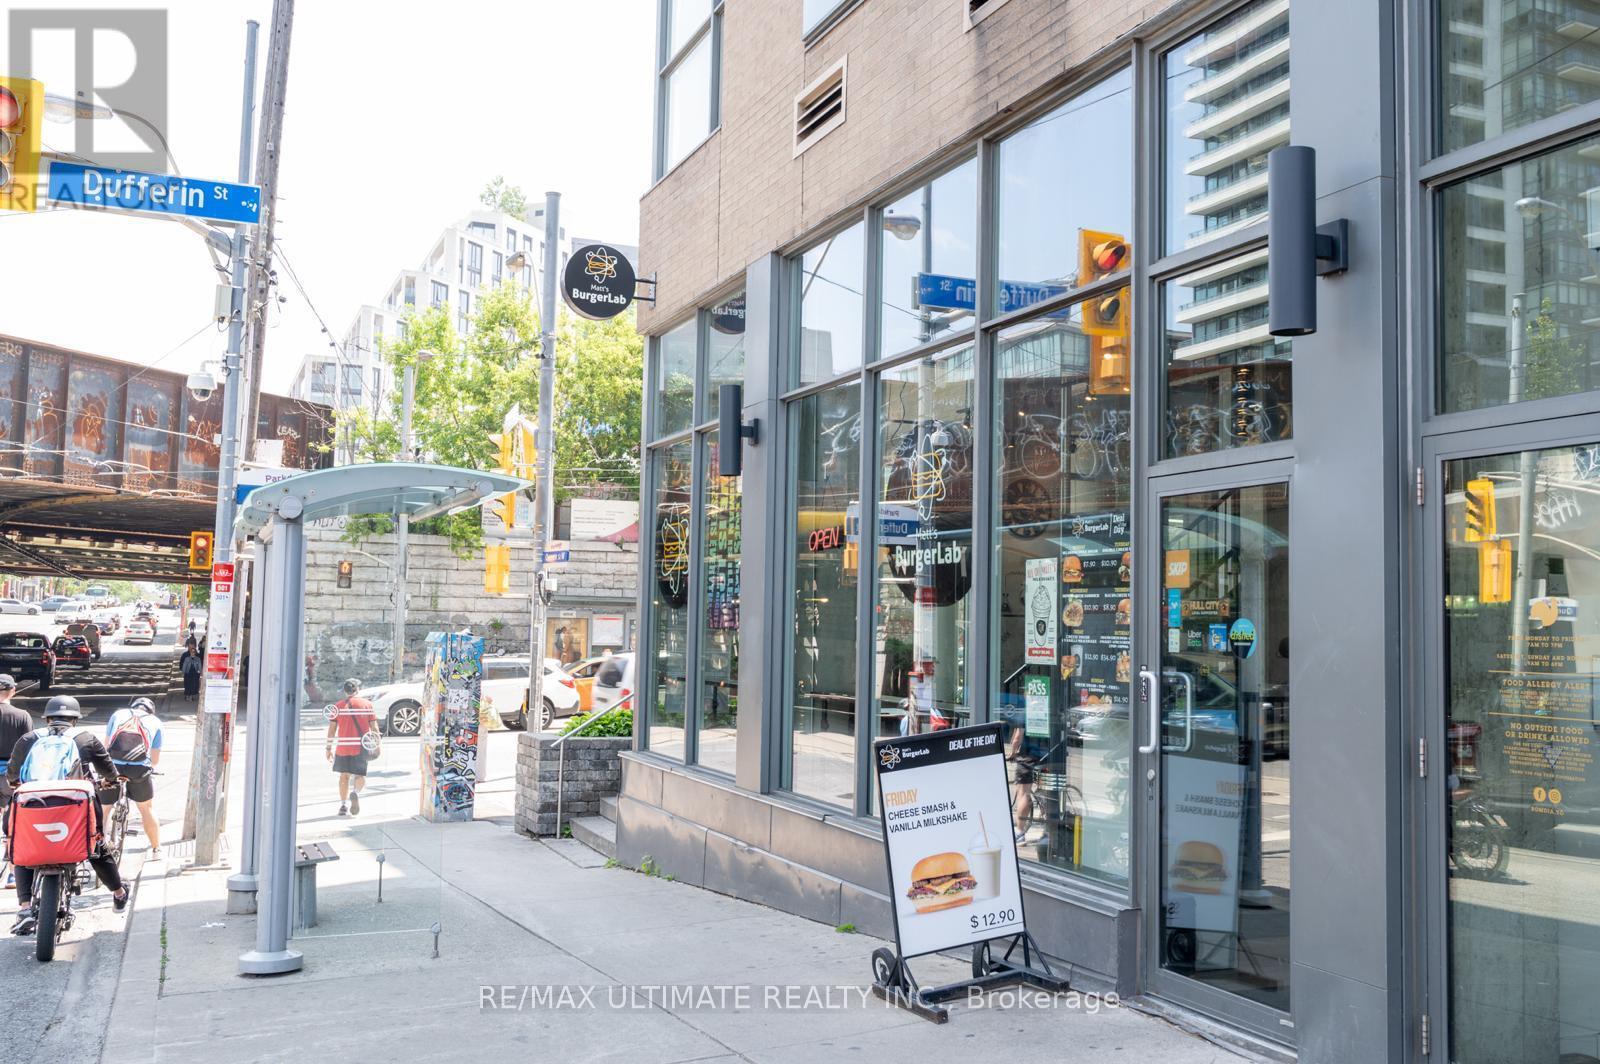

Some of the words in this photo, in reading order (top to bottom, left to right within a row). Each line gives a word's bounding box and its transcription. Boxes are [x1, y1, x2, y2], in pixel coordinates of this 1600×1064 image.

[83, 169, 205, 208] Dufferin
[214, 186, 229, 200] St
[572, 287, 627, 305] BurgerLab
[808, 525, 840, 551] OPEN
[915, 526, 938, 542] Matt's
[895, 539, 962, 573] BurgerLab
[1205, 601, 1220, 610] CITY
[1187, 629, 1202, 639] Uber
[1028, 682, 1047, 696] PASS
[1503, 679, 1524, 687] FOOD
[1526, 680, 1562, 689] ALLERGY
[1510, 722, 1522, 730] NO
[1524, 723, 1558, 733] OUTSIDE
[1560, 726, 1584, 735] FOOD
[948, 740, 965, 751] DEAL
[964, 739, 972, 749] OF
[972, 736, 985, 747] THE
[985, 733, 997, 745] DAY
[1505, 730, 1516, 738] OR
[1518, 732, 1548, 741] DRINKS
[1550, 735, 1590, 745] ALLOWED
[902, 748, 930, 759] BurgerLab
[885, 789, 918, 807] FRIDAY
[888, 807, 920, 821] CHEESE
[921, 802, 949, 815] SMASH
[950, 800, 957, 809] &
[889, 820, 923, 834] VANILLA
[923, 811, 968, 827] MILKSHAKE
[982, 909, 1015, 926] 12.90
